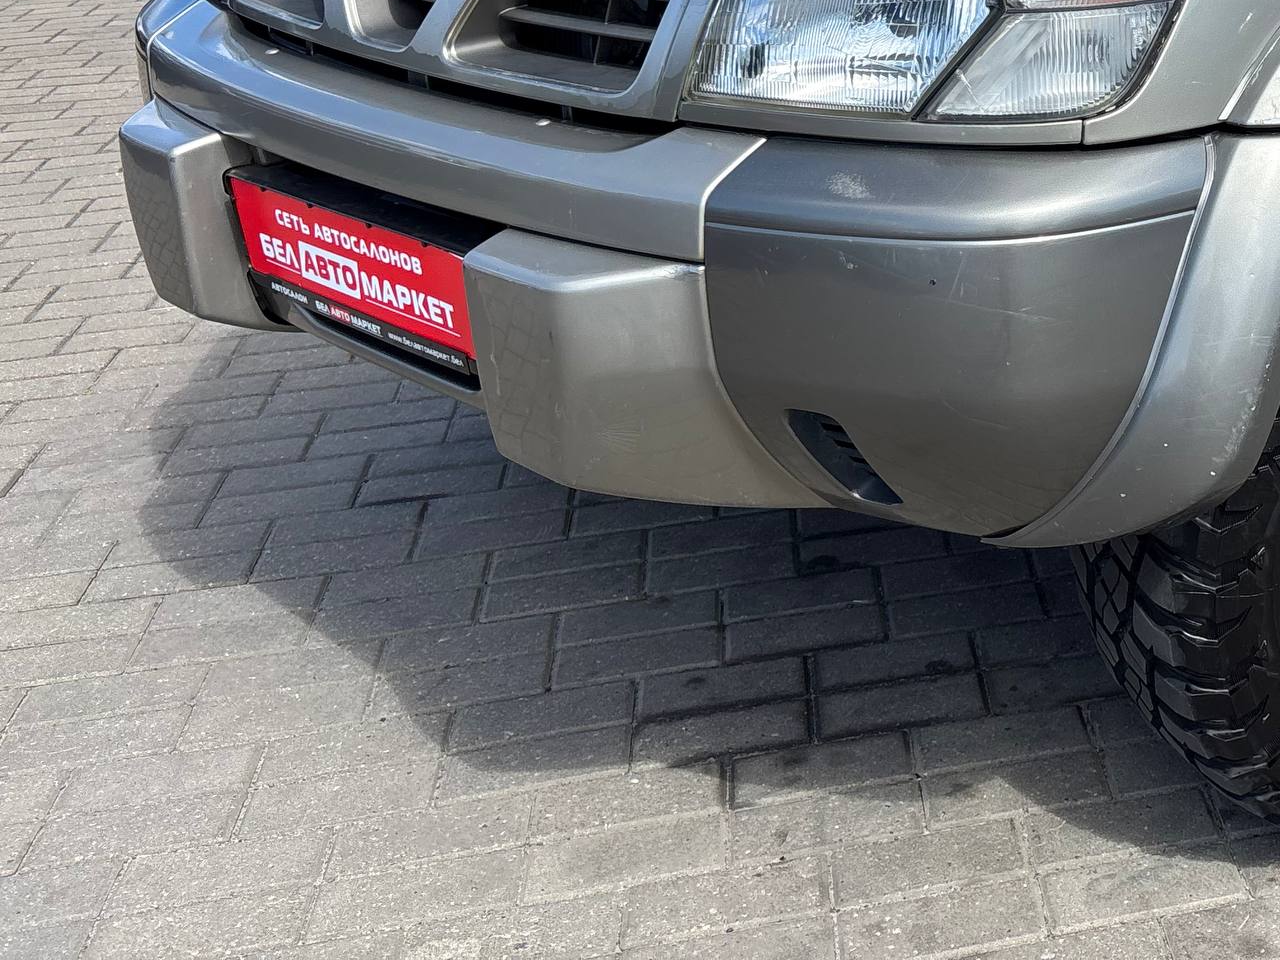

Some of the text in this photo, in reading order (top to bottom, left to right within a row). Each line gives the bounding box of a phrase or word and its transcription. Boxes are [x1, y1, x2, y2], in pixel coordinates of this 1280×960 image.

[275, 209, 422, 275] СЕТЬ АВТОСАЛОНОВ
[271, 281, 309, 304] АВТОСАЛОН
